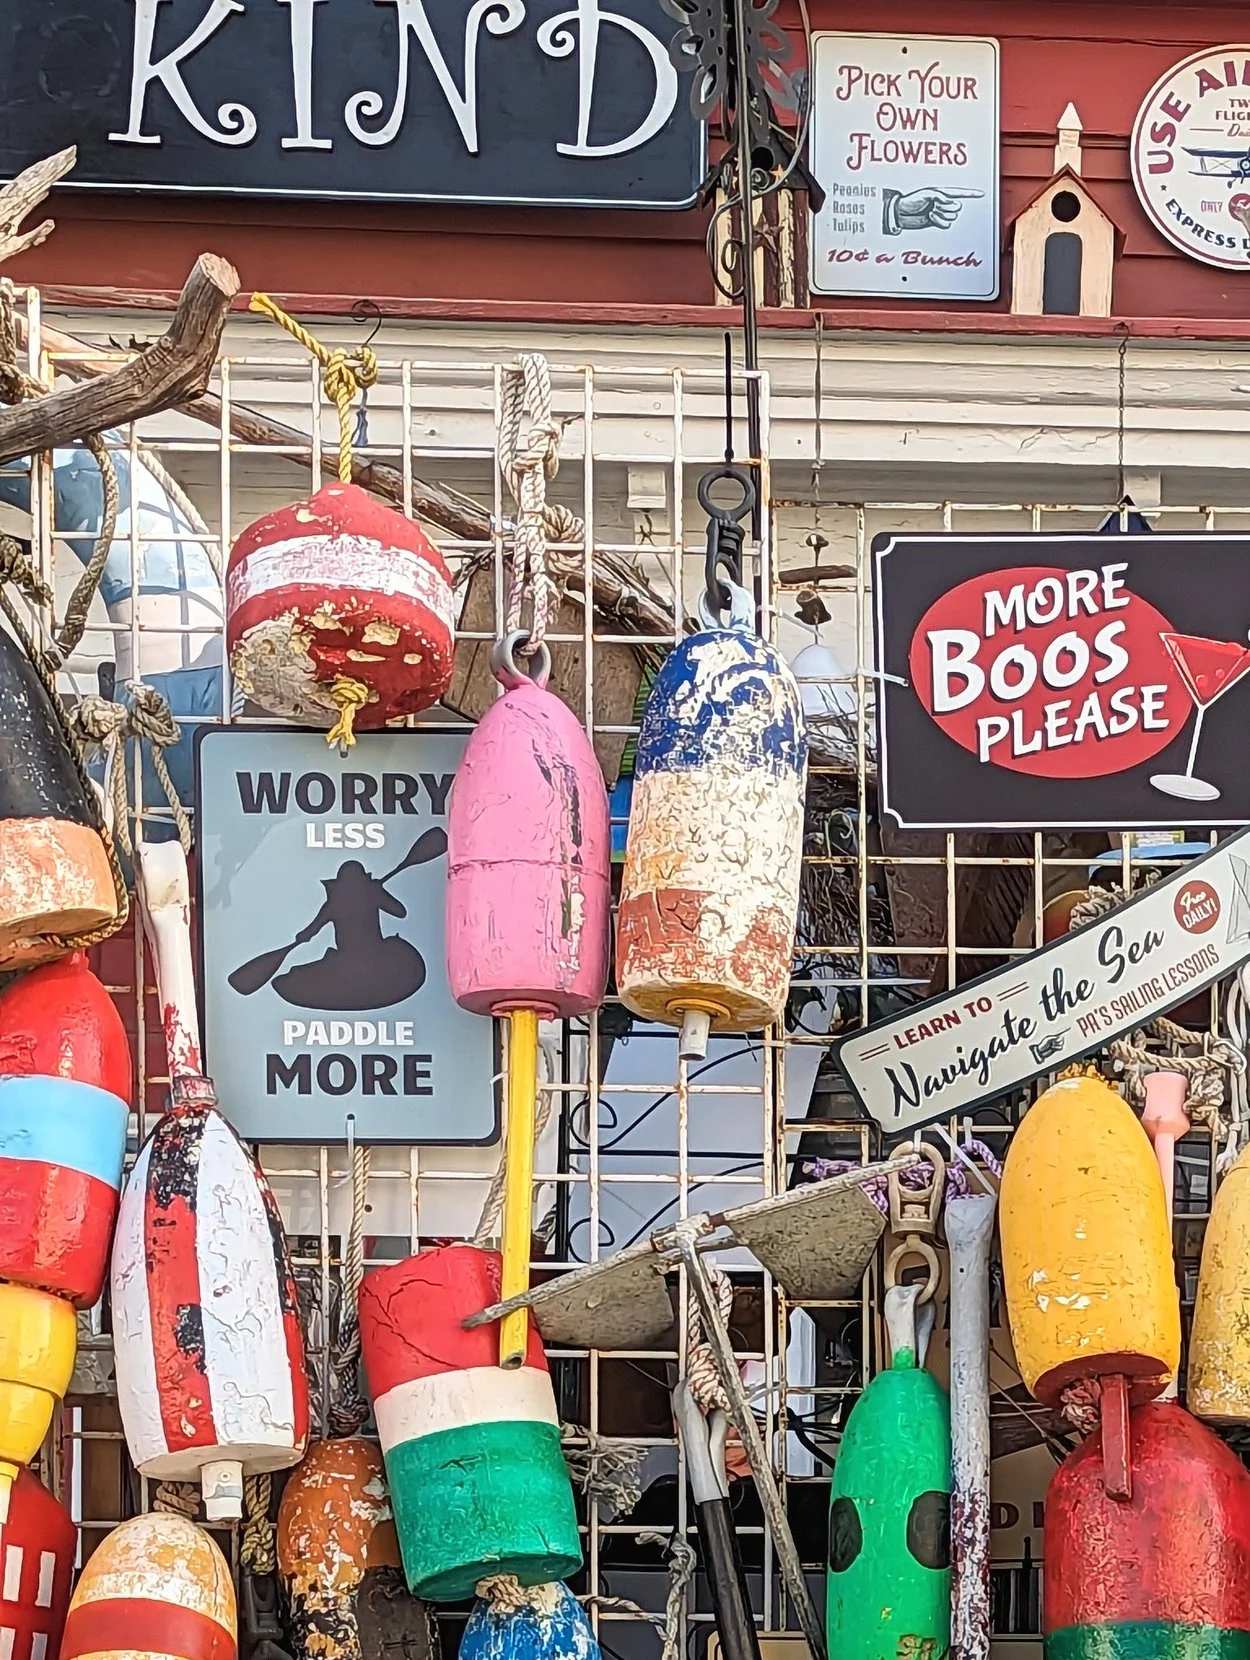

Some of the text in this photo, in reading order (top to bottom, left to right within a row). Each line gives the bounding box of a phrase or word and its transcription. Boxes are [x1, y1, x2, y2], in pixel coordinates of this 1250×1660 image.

[108, 0, 679, 157] KIND
[836, 61, 978, 103] PICK YOUR
[876, 102, 938, 132] OWN
[1147, 91, 1192, 174] USE
[846, 133, 967, 170] FLOWERS
[833, 183, 876, 197] Peonies
[833, 201, 865, 215] Roses
[833, 218, 865, 234] Tulips
[1165, 199, 1237, 248] EXPRESS
[827, 249, 983, 267] 10¢ a Bunch
[984, 562, 1131, 637] MORE
[927, 620, 1129, 713] BOOS
[977, 684, 1170, 763] PLEASE
[236, 771, 457, 815] WORRY
[306, 822, 385, 849] LESS
[1180, 891, 1206, 912] Free
[1182, 898, 1218, 929] DAILY!
[1076, 943, 1221, 1038] PA'S SAILING LESSONS
[283, 1020, 414, 1046] PADDLE
[884, 926, 1165, 1117] Navigate the Sea
[893, 997, 993, 1050] LEARN TO
[266, 1053, 434, 1096] MORE
